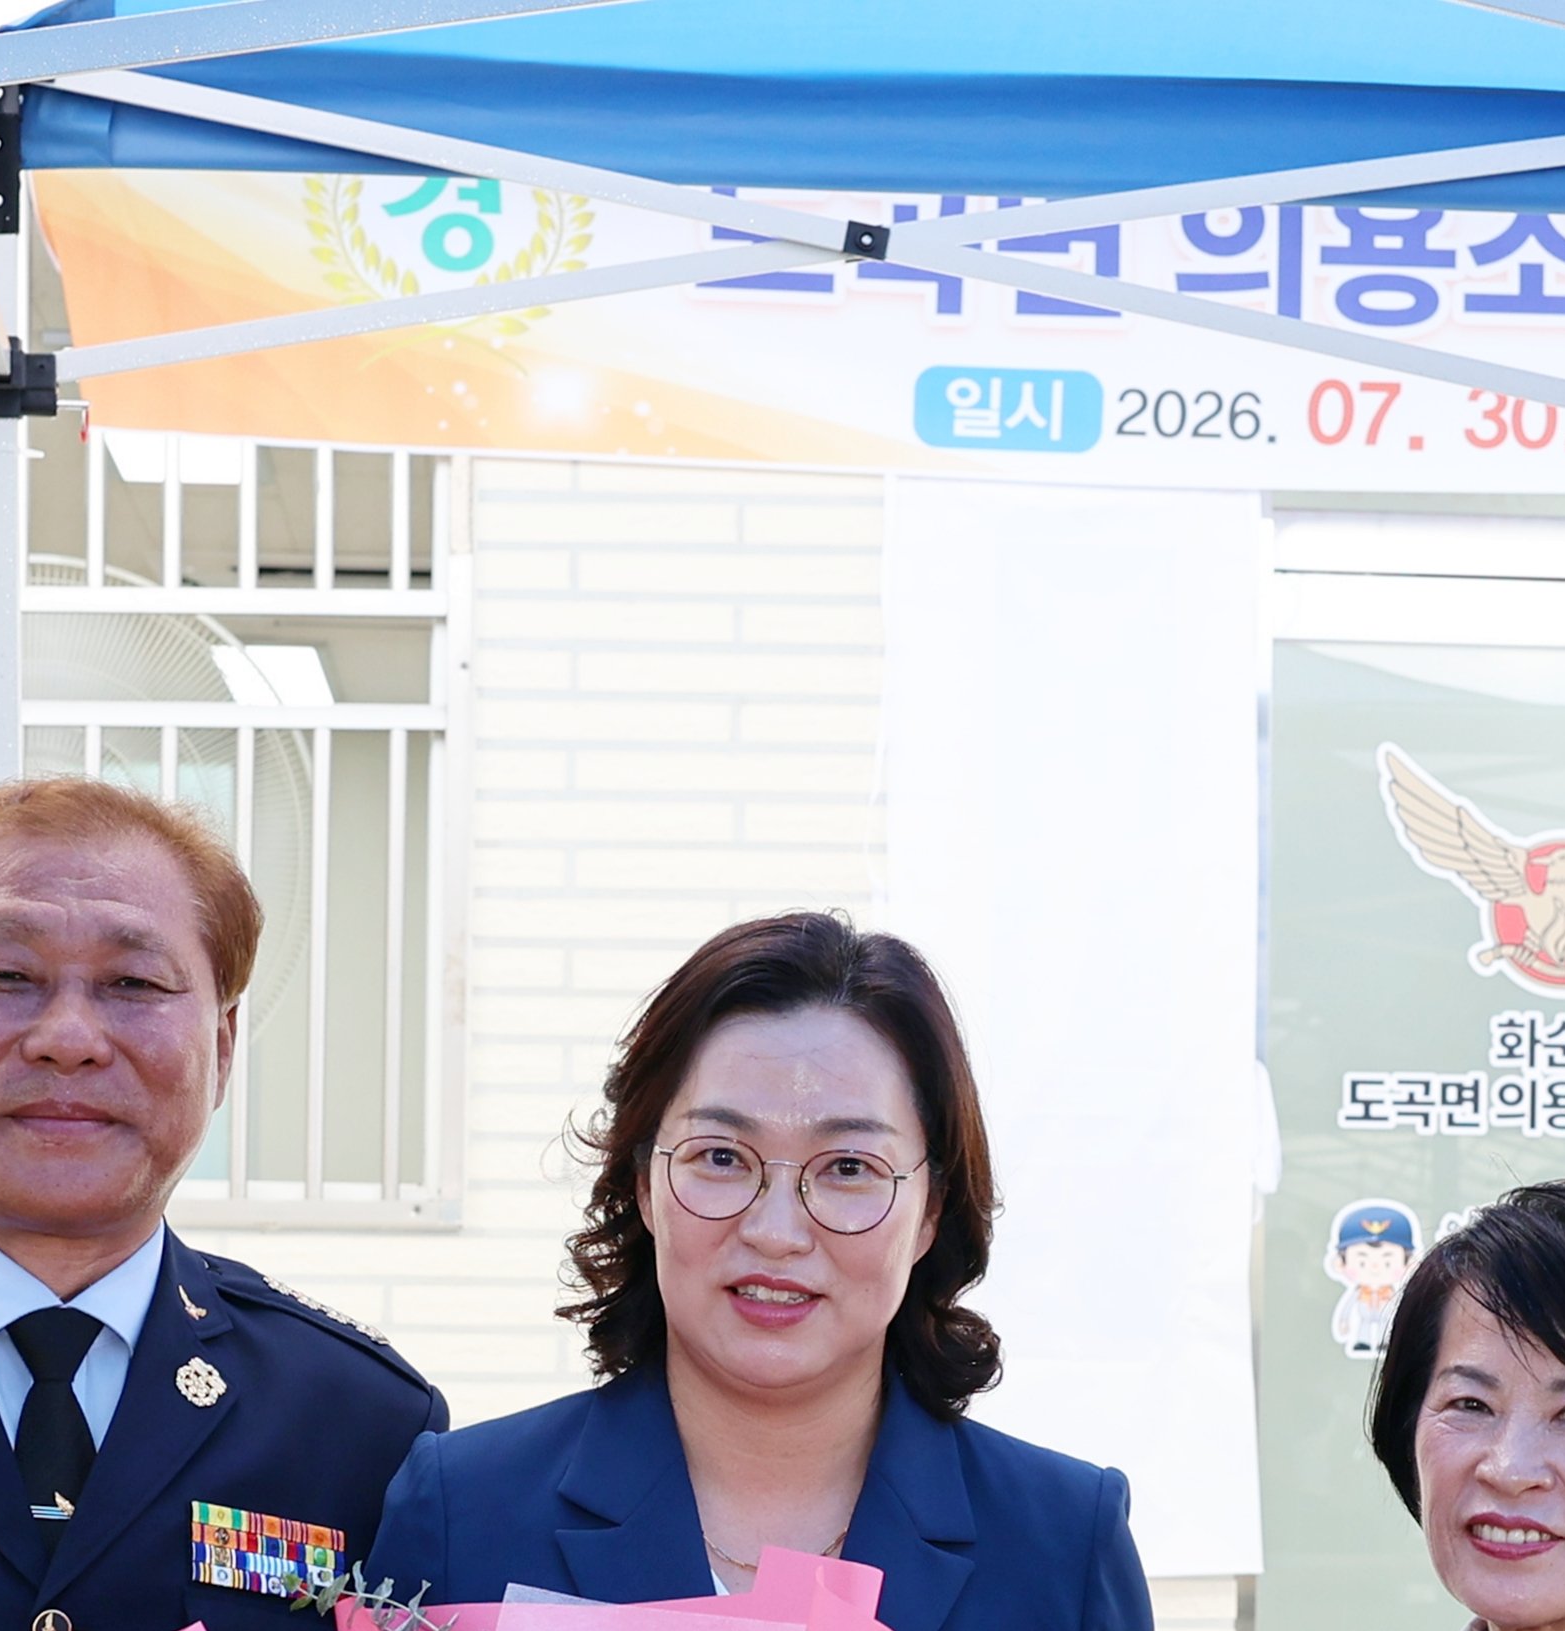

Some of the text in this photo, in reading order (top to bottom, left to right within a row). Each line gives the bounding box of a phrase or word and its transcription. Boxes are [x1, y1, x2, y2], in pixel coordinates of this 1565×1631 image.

[382, 177, 502, 271] 경
[945, 377, 1064, 441] 일시
[1116, 388, 1276, 444] 2026.
[1308, 379, 1424, 451] 07.
[1345, 1079, 1480, 1127] 도곡면
